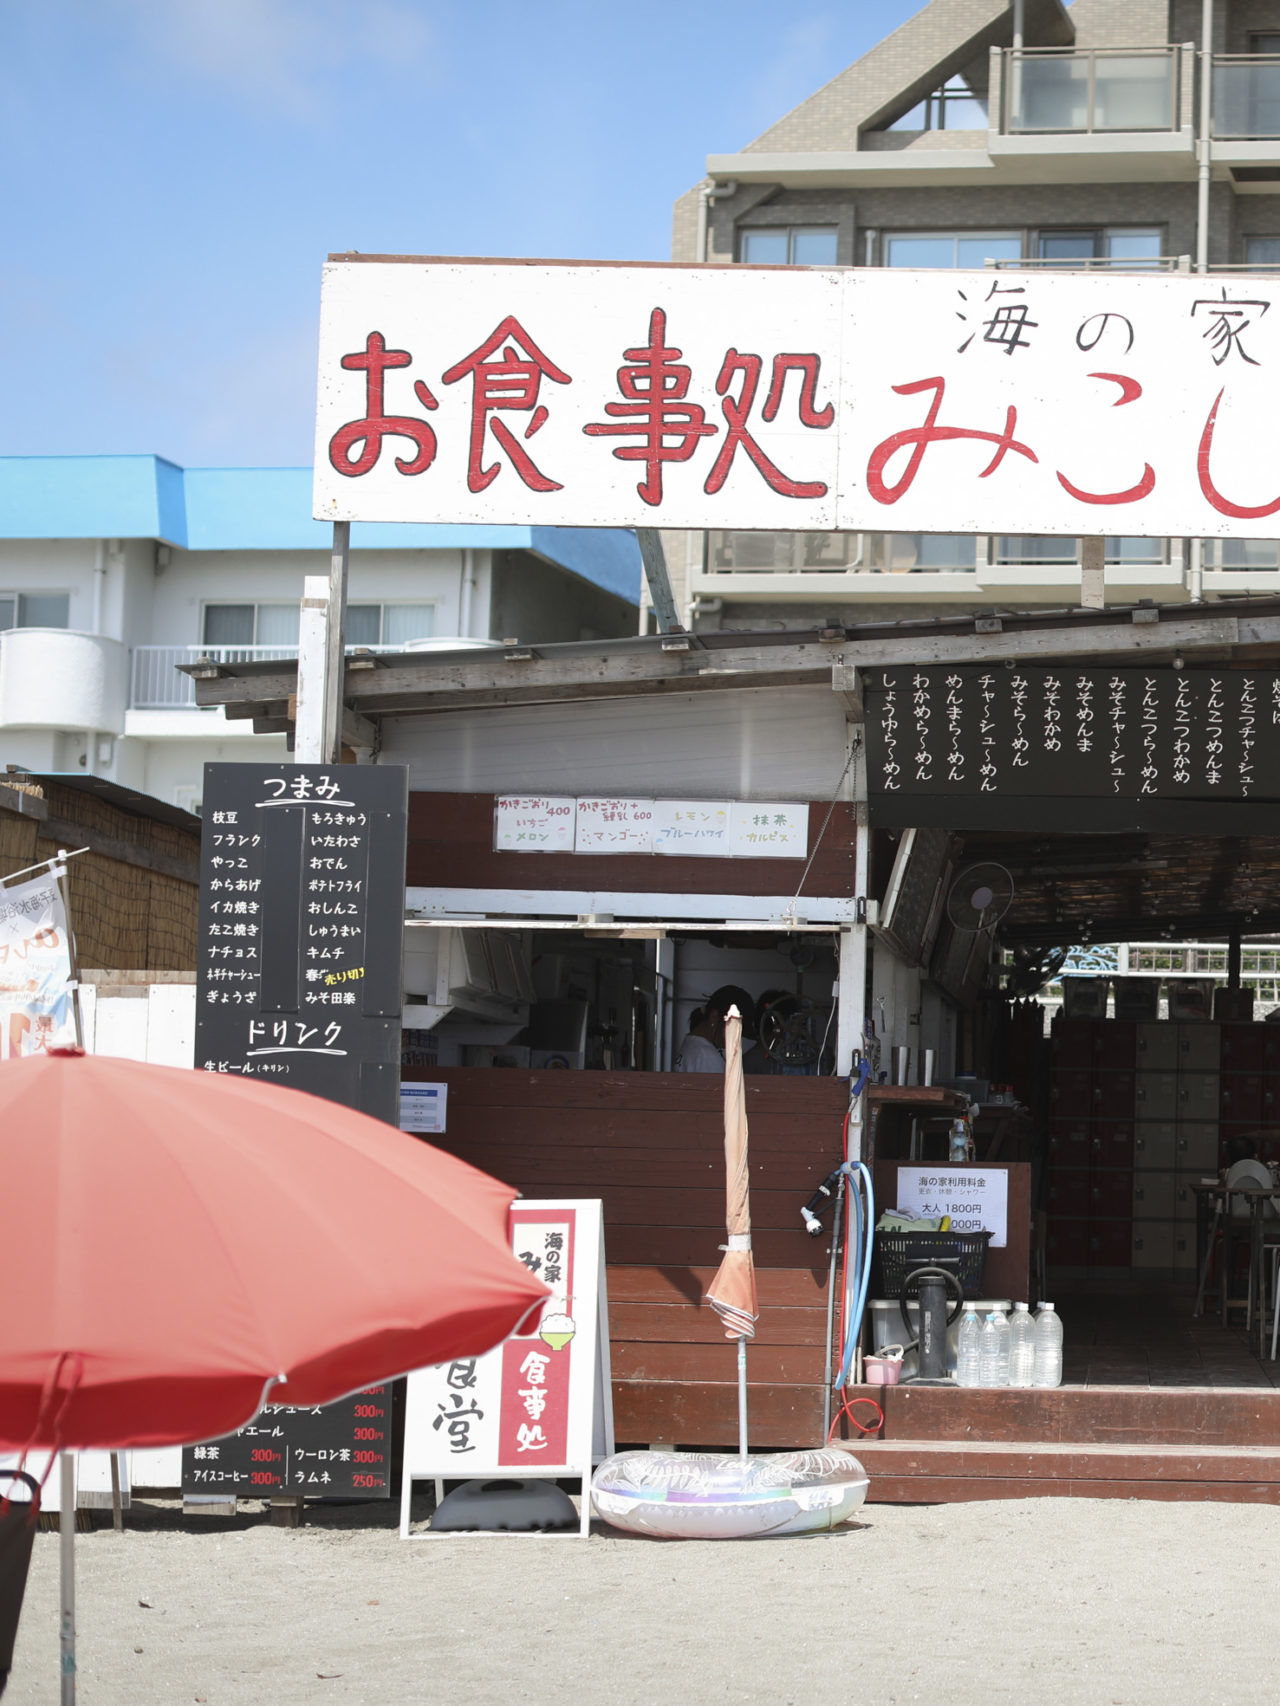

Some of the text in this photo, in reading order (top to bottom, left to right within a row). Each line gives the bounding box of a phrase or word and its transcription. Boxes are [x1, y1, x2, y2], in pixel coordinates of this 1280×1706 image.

[329, 306, 836, 507] お食事処
[1043, 676, 1062, 751] みそわかめ
[1076, 676, 1094, 752] みそめんま
[1173, 678, 1191, 784] とんこつわかめ
[1206, 678, 1224, 784] とんこつめんま
[264, 775, 340, 799] つまみ
[499, 798, 549, 810] かきごおり
[213, 811, 238, 824] 枝豆
[547, 808, 570, 816] 400
[634, 812, 652, 820] 600
[675, 812, 710, 821] レモン
[312, 812, 367, 826] もろきゅう
[516, 819, 548, 828] いちご
[753, 814, 787, 826] 抹茶
[517, 833, 549, 841] メロン
[594, 829, 638, 841] マンゴー
[661, 826, 724, 838] ブルーハワイ
[746, 831, 788, 842] カルピス
[212, 834, 261, 846] フランク
[311, 835, 361, 848] いたわさ
[211, 856, 248, 869] やっこ
[309, 857, 347, 869] おでん
[210, 878, 261, 892] からあげ
[309, 879, 362, 892] ポテトフライ
[210, 901, 260, 913] イカ焼き
[308, 902, 358, 914] おしんこ
[209, 923, 259, 936] たこ焼き
[308, 923, 361, 937] しゅうまい
[208, 947, 257, 959] ナチョス
[307, 947, 344, 960] キムチ
[207, 968, 260, 981] ネギチャーシュー
[206, 991, 256, 1004] ぎょうざ
[305, 992, 356, 1004] みそ田楽
[247, 1020, 341, 1046] ドリンク
[918, 1177, 986, 1187] 海の家利用料金
[922, 1204, 981, 1213] 大人 1800円
[951, 1220, 981, 1229] 000円
[544, 1232, 563, 1283] 海の家
[517, 1351, 550, 1452] 食事処
[194, 1447, 219, 1460] 緑茶
[295, 1449, 350, 1462] ウーロン茶
[194, 1471, 248, 1482] アイスコーヒー
[295, 1471, 331, 1484] ラムネ
